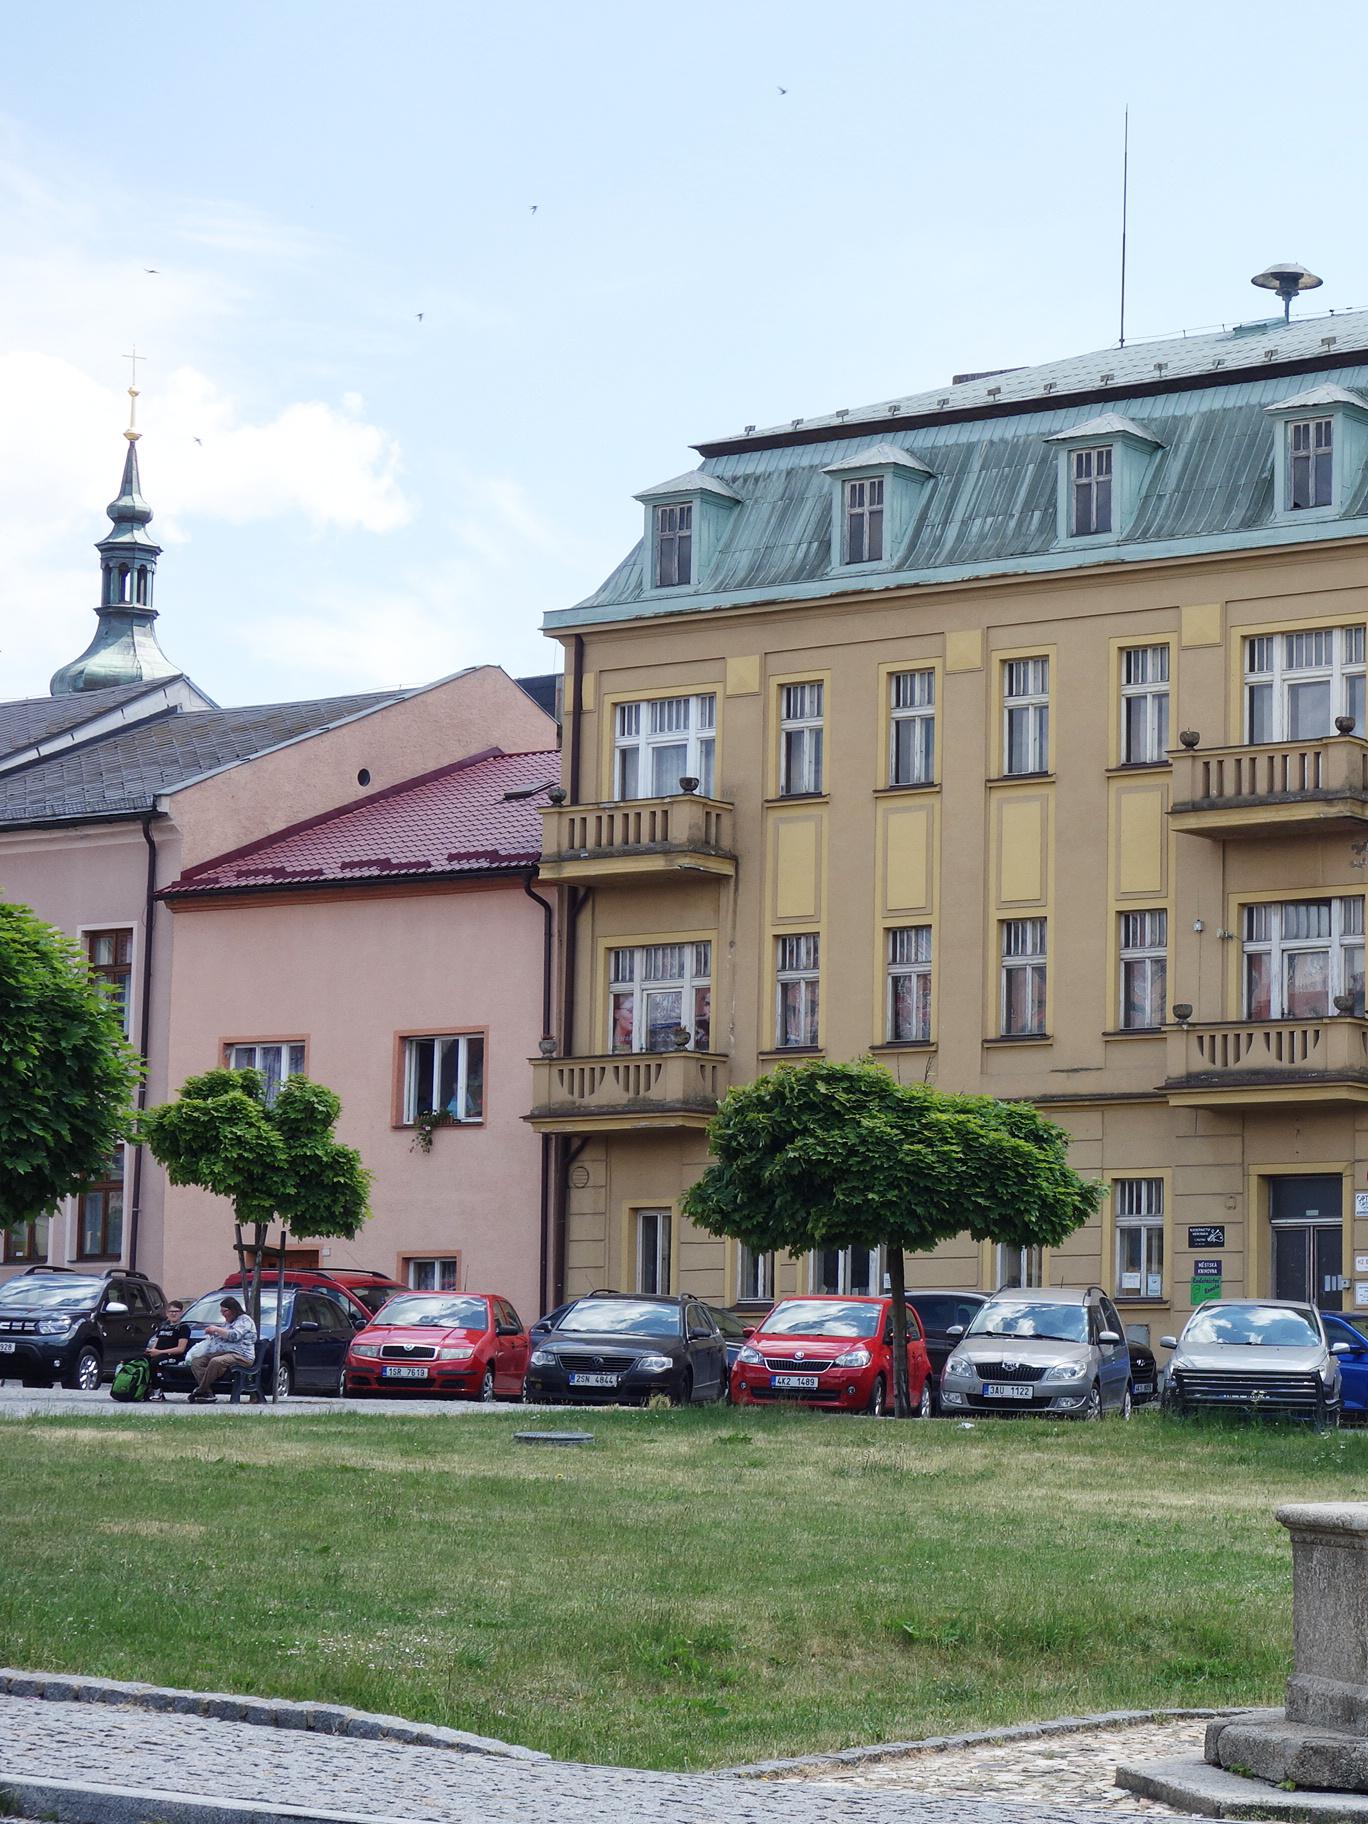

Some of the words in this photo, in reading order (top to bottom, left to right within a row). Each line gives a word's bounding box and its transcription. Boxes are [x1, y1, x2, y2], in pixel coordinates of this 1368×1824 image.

[389, 1368, 401, 1376] 1SR
[407, 1369, 425, 1377] 7619
[576, 1375, 590, 1383] 2SN
[594, 1376, 614, 1384] 4844
[777, 1377, 791, 1386] 4K2
[797, 1378, 815, 1386] 1489
[990, 1386, 1005, 1395] 3AU
[1011, 1387, 1029, 1396] 1122
